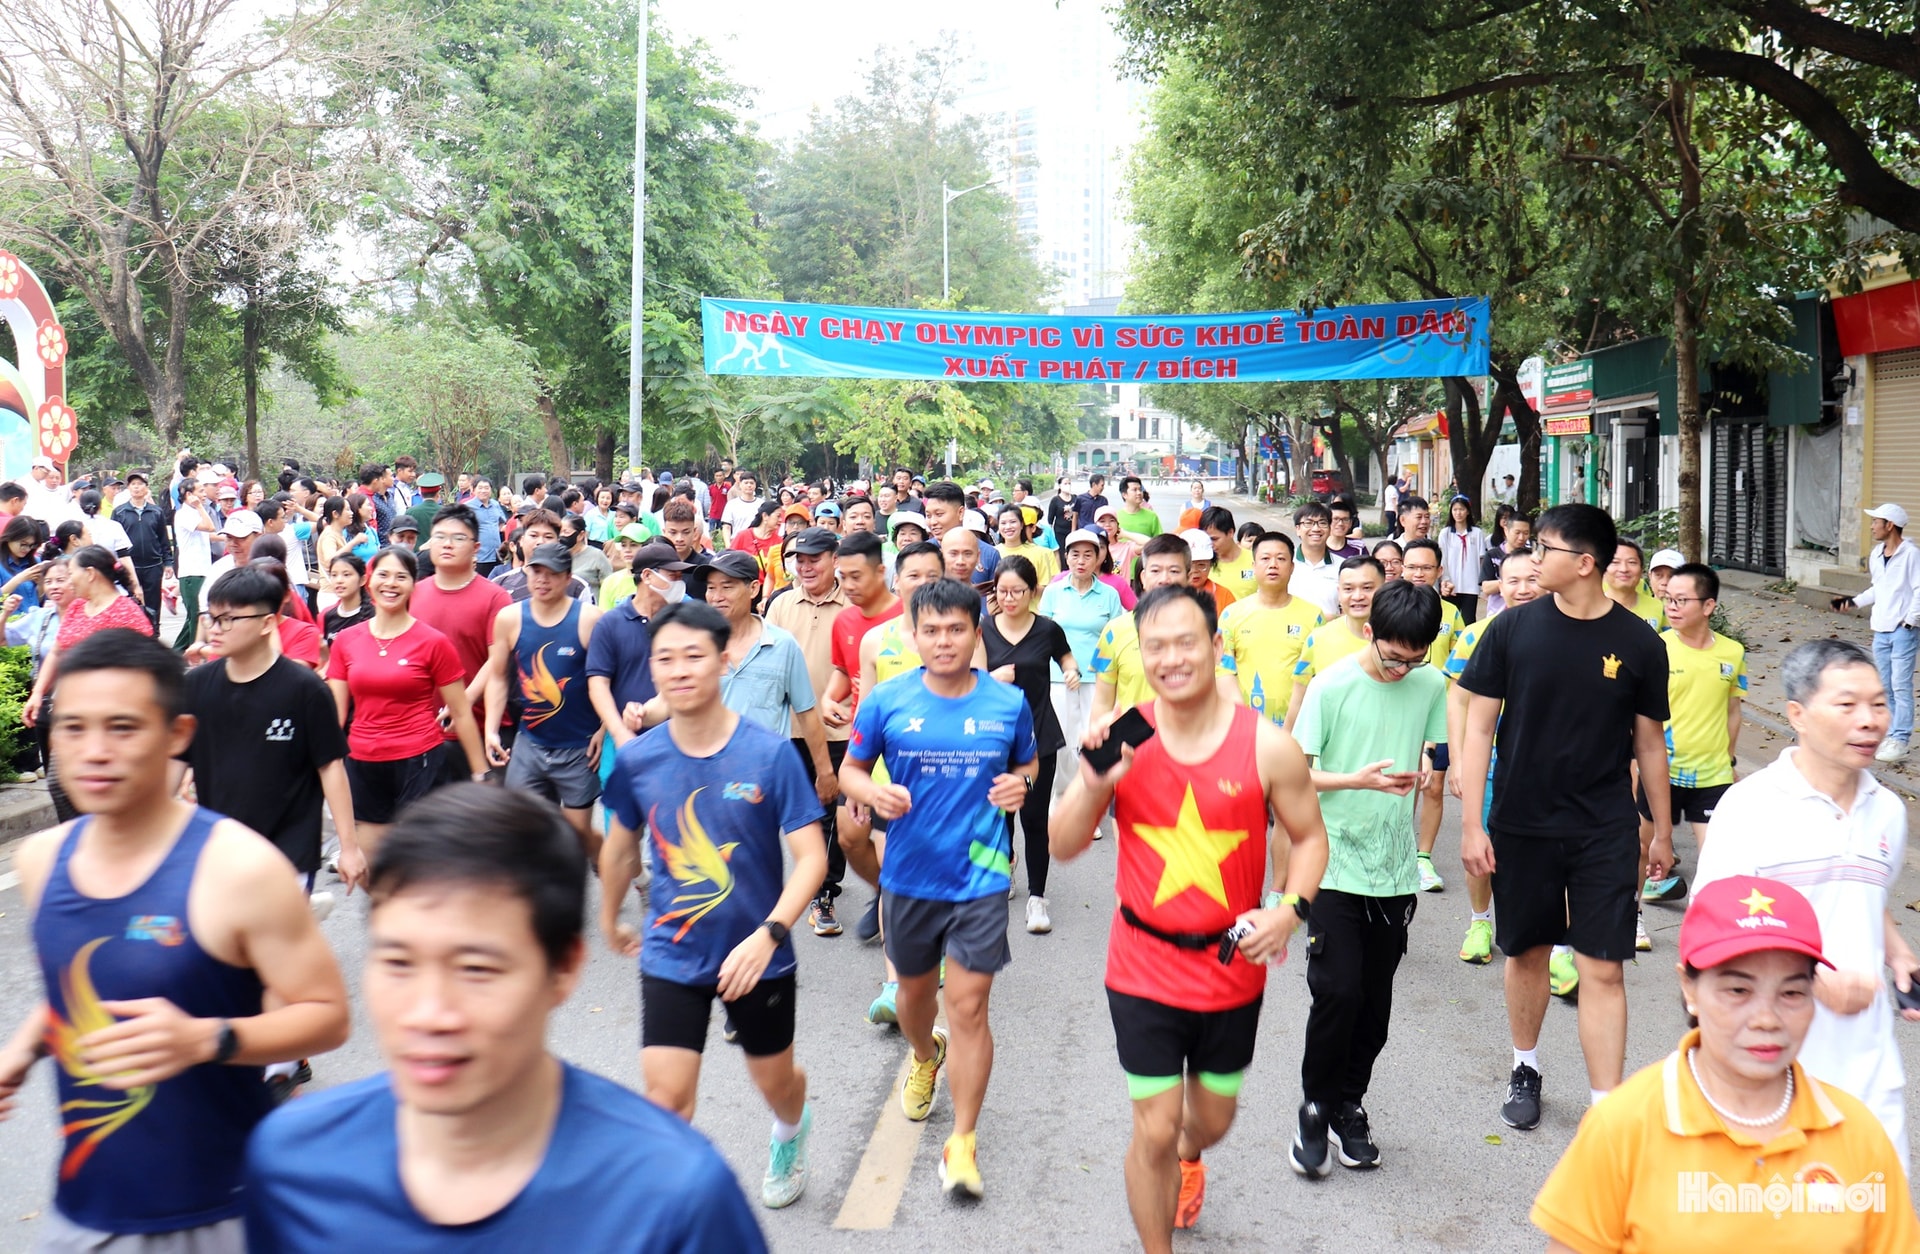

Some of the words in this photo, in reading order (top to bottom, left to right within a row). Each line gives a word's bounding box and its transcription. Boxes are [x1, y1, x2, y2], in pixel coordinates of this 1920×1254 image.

[723, 310, 809, 337] NGÀY
[820, 316, 905, 345] CHẠY
[915, 322, 1063, 348] OLYMPIC
[1072, 323, 1105, 348] VÌ
[1115, 322, 1185, 348] SỨC
[1196, 315, 1285, 347] KHOẺ
[1295, 313, 1385, 342] TOÀN
[1396, 308, 1466, 338] DÂN
[943, 352, 1029, 379] XUẤT
[1039, 358, 1125, 380] PHÁT
[1132, 360, 1149, 380] /
[1157, 357, 1238, 379] ĐÍCH
